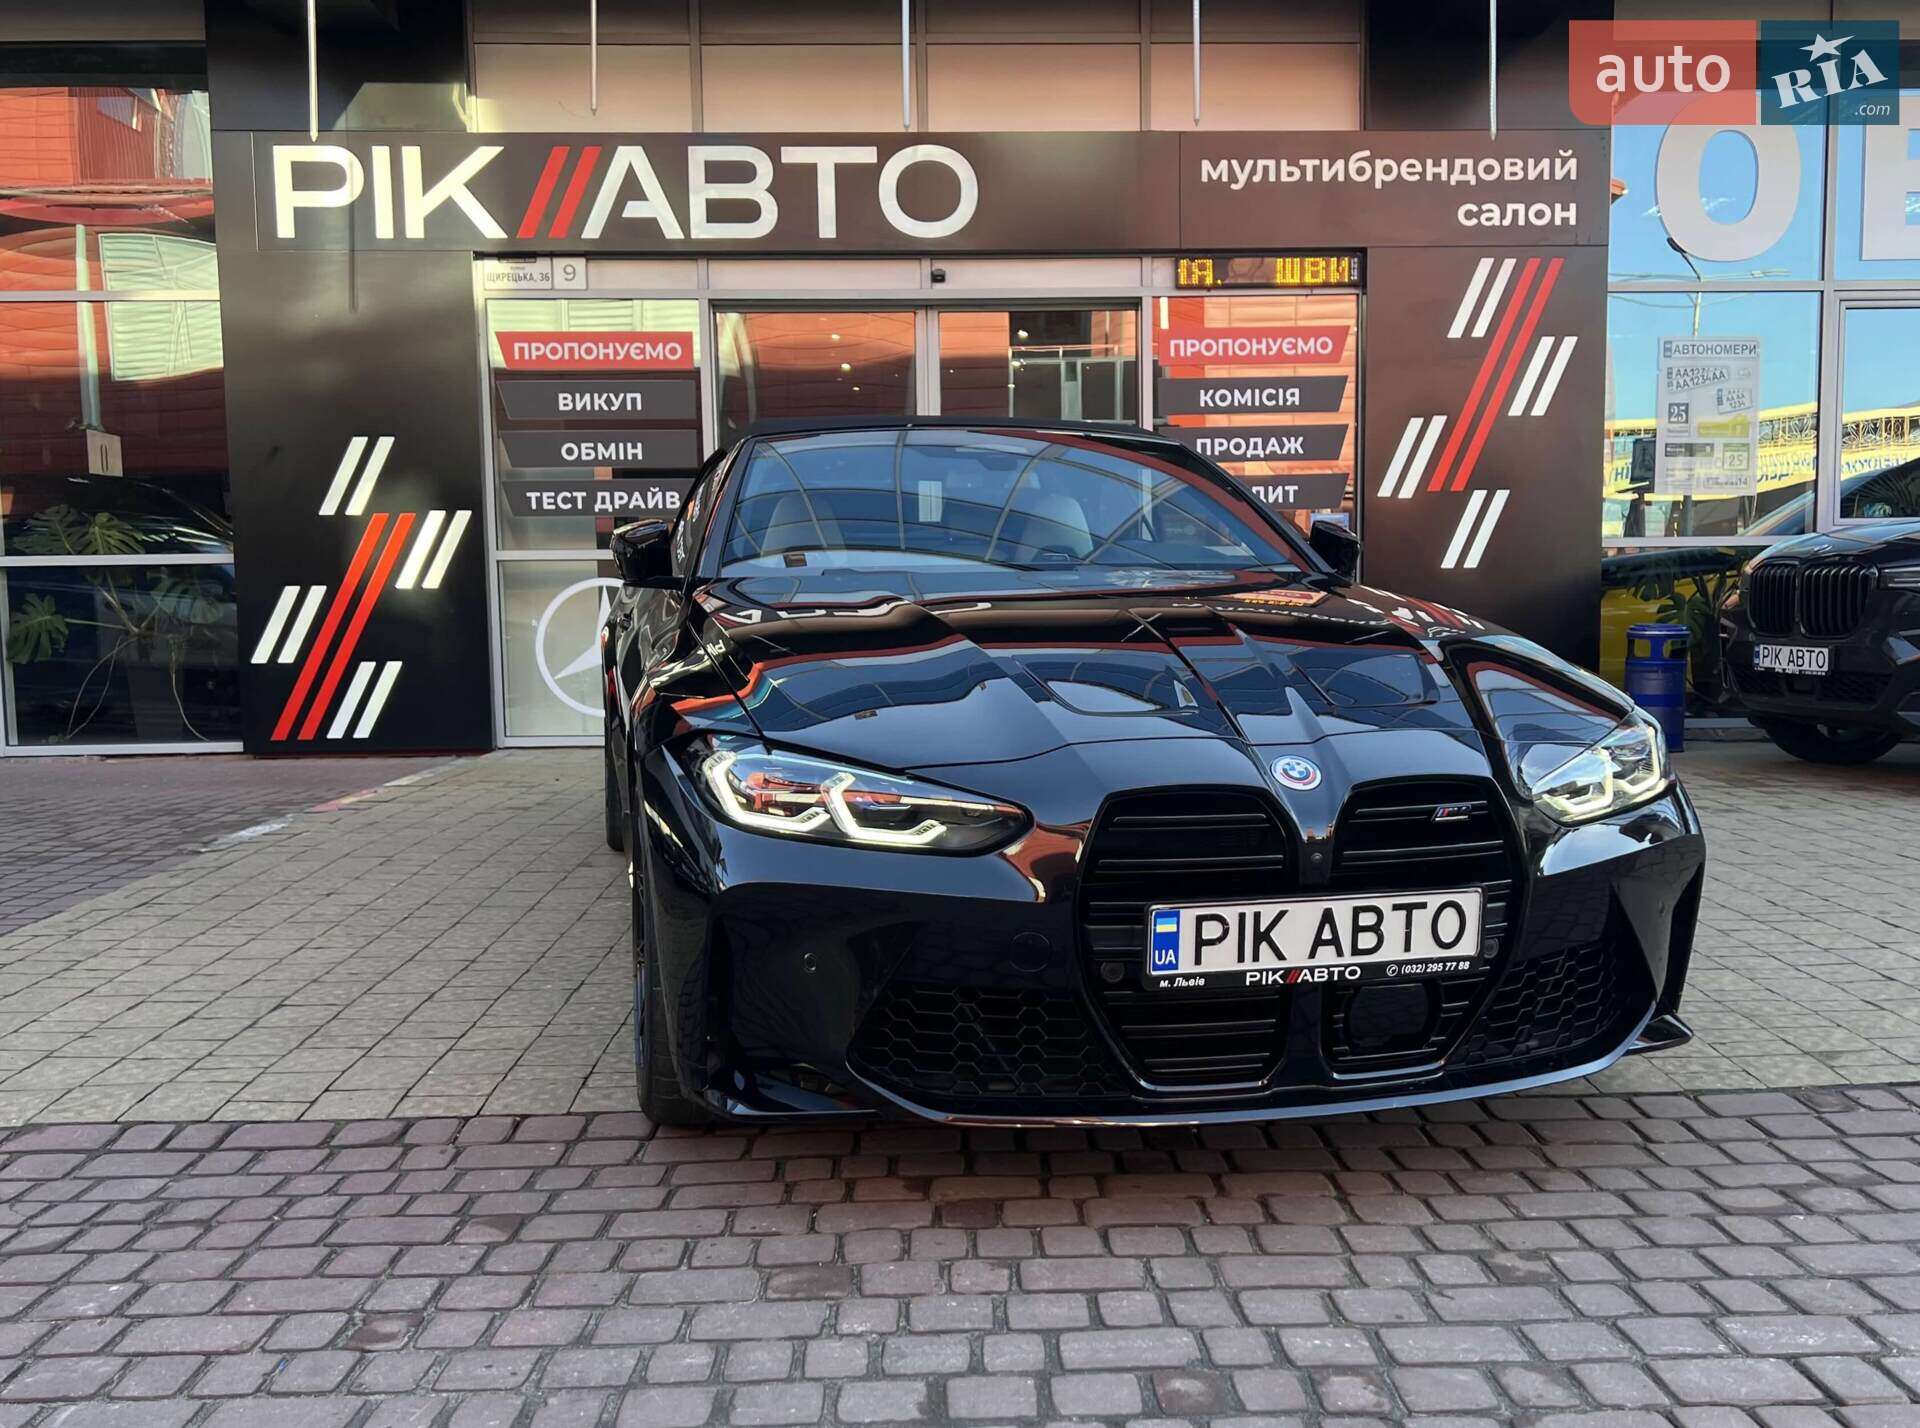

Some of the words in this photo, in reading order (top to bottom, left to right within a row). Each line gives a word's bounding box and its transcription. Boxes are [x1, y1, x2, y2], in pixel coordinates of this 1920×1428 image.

[1200, 149, 1577, 190] мультибрендовий
[1457, 202, 1577, 227] салон
[539, 272, 551, 281] 36
[563, 264, 576, 281] 9
[513, 342, 682, 360] ПРОПОНУЄМО
[1170, 336, 1333, 357] ПРОПОНУЄМО
[1673, 343, 1757, 355] АВТОНОМЕРИ
[558, 393, 642, 411] ВИКУП
[1200, 388, 1300, 407] КОМІСІЯ
[1670, 405, 1687, 422] 25
[561, 442, 643, 461] ОБМІН
[1196, 436, 1304, 458] ПРОДАЖ
[1729, 454, 1744, 467] 25
[526, 491, 587, 510] ТЕСТ
[594, 487, 680, 512] ДРАЙВ
[1762, 647, 1782, 665] РІК
[1787, 649, 1826, 668] АВТО
[1194, 910, 1289, 966] РІК
[1308, 900, 1466, 959] АВТО
[1155, 950, 1176, 965] UA
[1401, 964, 1426, 974] (032)
[1426, 962, 1443, 972] 295
[1445, 962, 1456, 971] 77
[1458, 961, 1470, 970] 88
[1173, 977, 1205, 987] Львів
